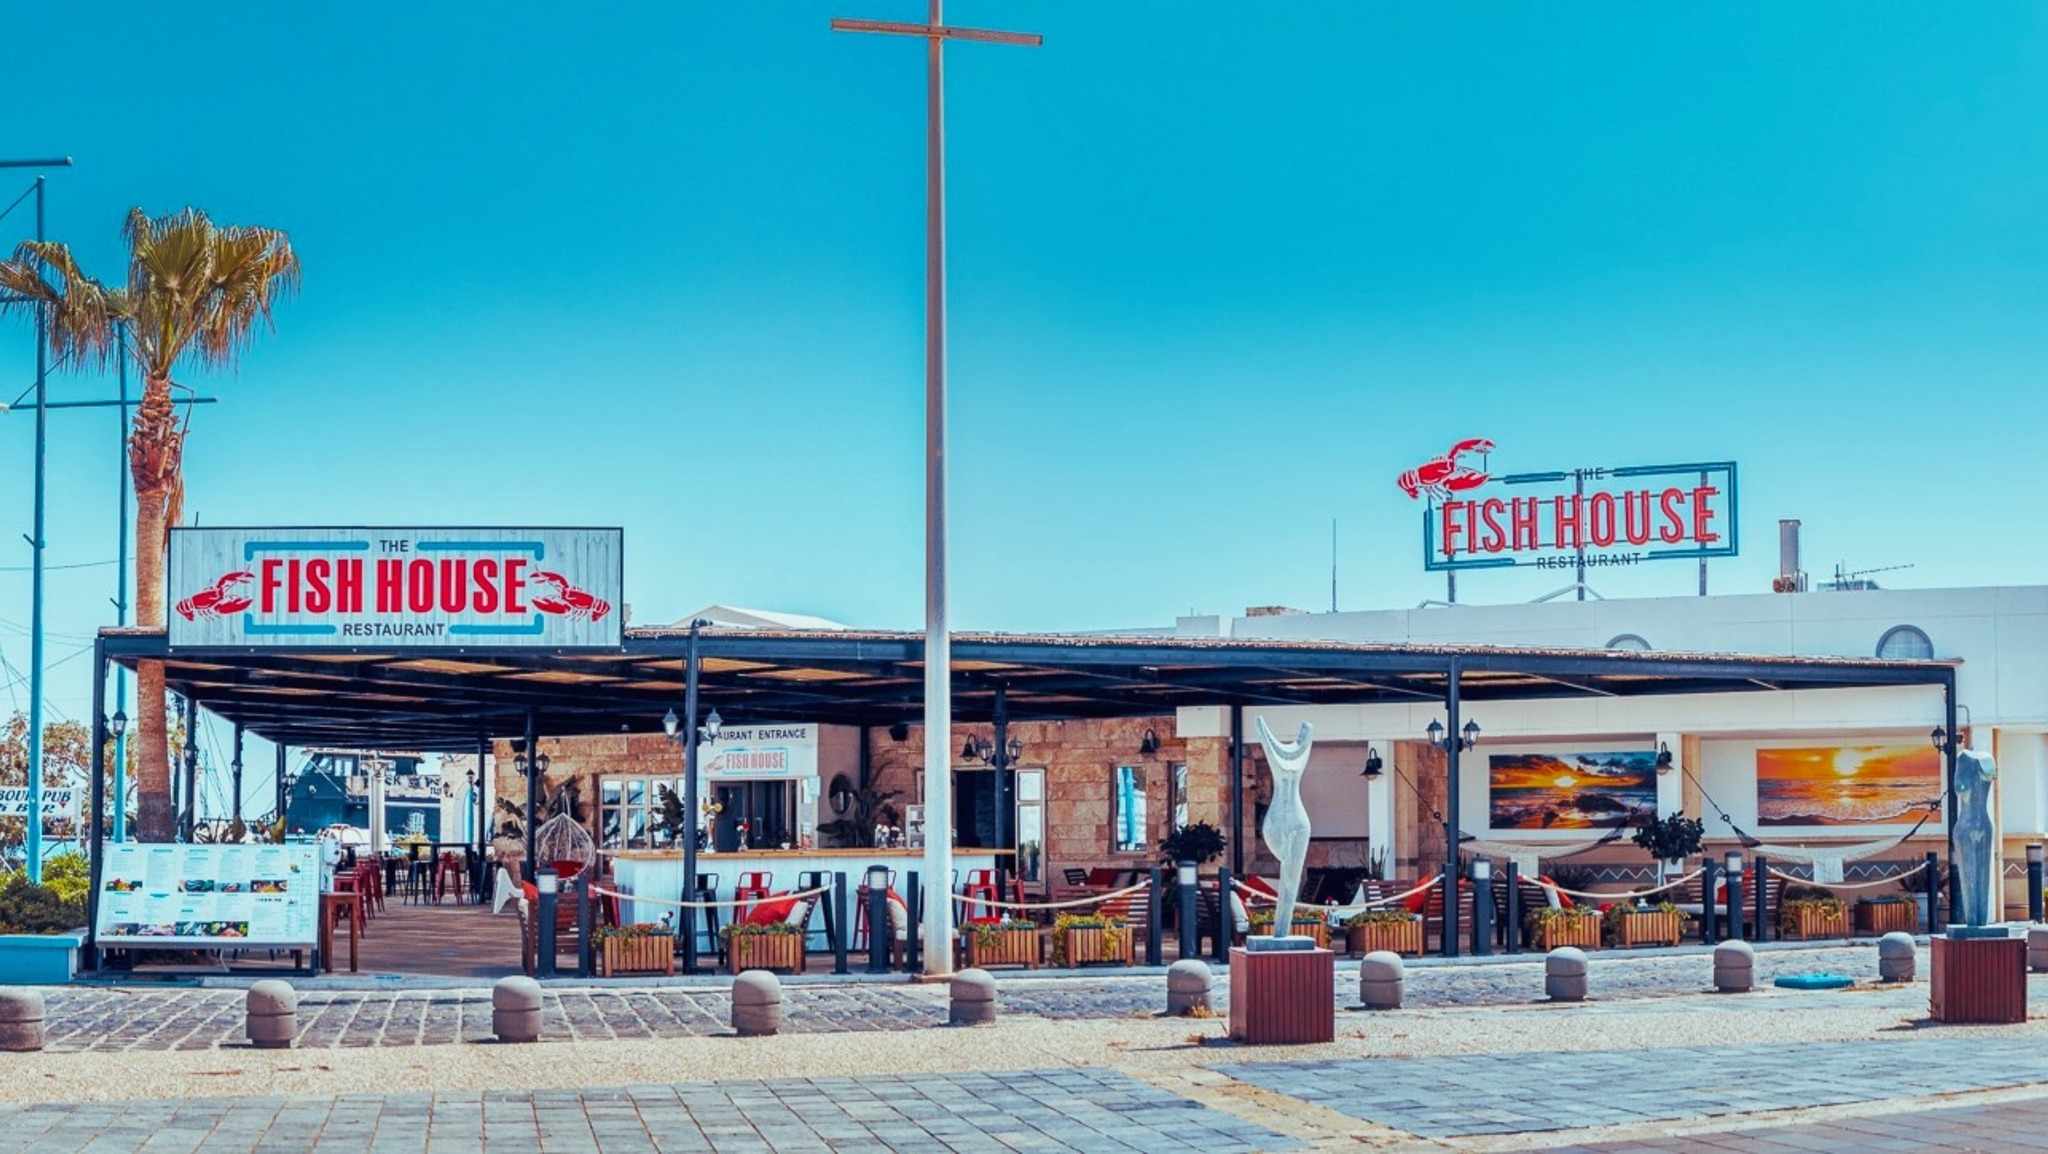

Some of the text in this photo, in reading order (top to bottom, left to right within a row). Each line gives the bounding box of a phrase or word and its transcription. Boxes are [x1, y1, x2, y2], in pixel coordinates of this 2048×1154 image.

[1574, 467, 1605, 481] THE
[1442, 486, 1719, 555] FISH HOUSE
[379, 539, 409, 553] THE
[1537, 552, 1641, 569] RESTAURANT
[260, 558, 528, 614] FISH HOUSE
[342, 623, 445, 637] RESTAURANT
[758, 727, 807, 740] ENTRANCE
[726, 751, 785, 770] FISH HOUSE
[42, 790, 72, 802] PUB
